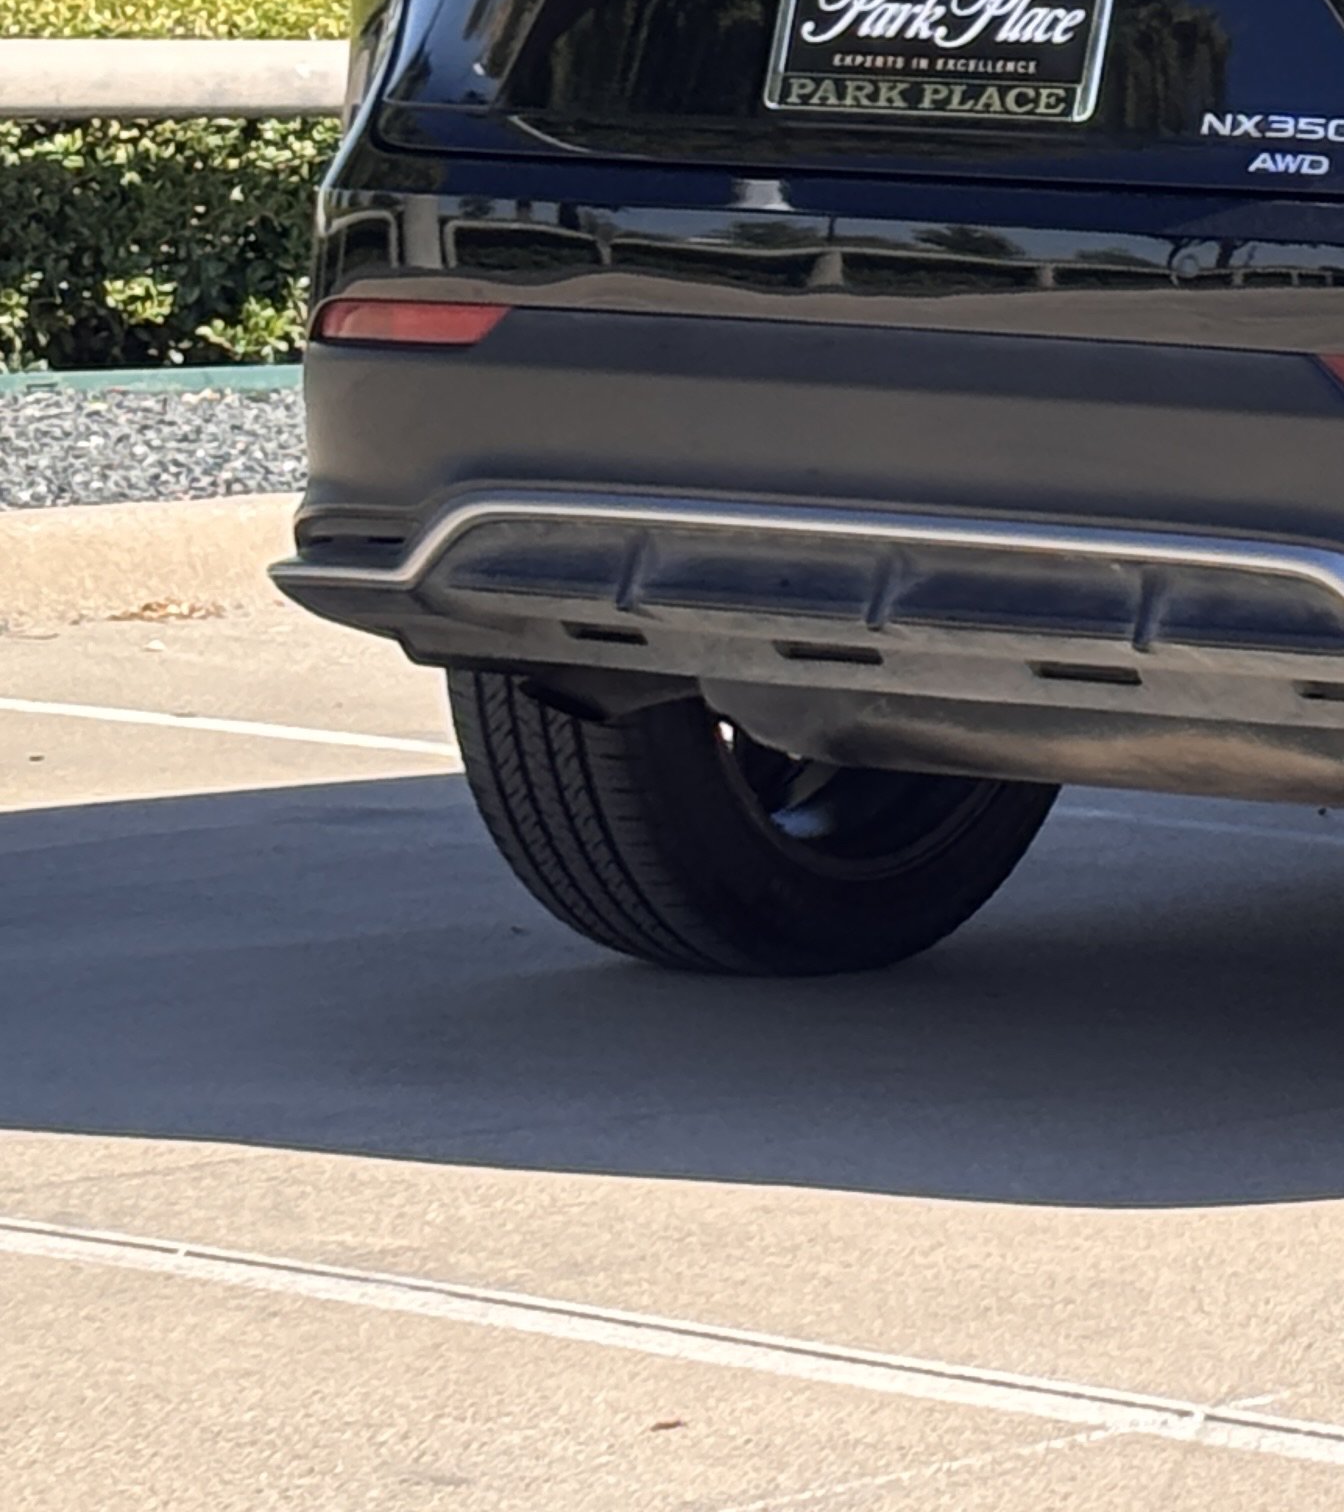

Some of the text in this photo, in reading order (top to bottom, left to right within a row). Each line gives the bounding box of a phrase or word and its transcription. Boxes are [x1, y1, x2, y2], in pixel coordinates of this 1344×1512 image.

[832, 53, 1037, 74] EXPERTS IN EXCELLENCE
[787, 77, 1067, 115] PARK PLACE
[1248, 151, 1330, 175] AWD
